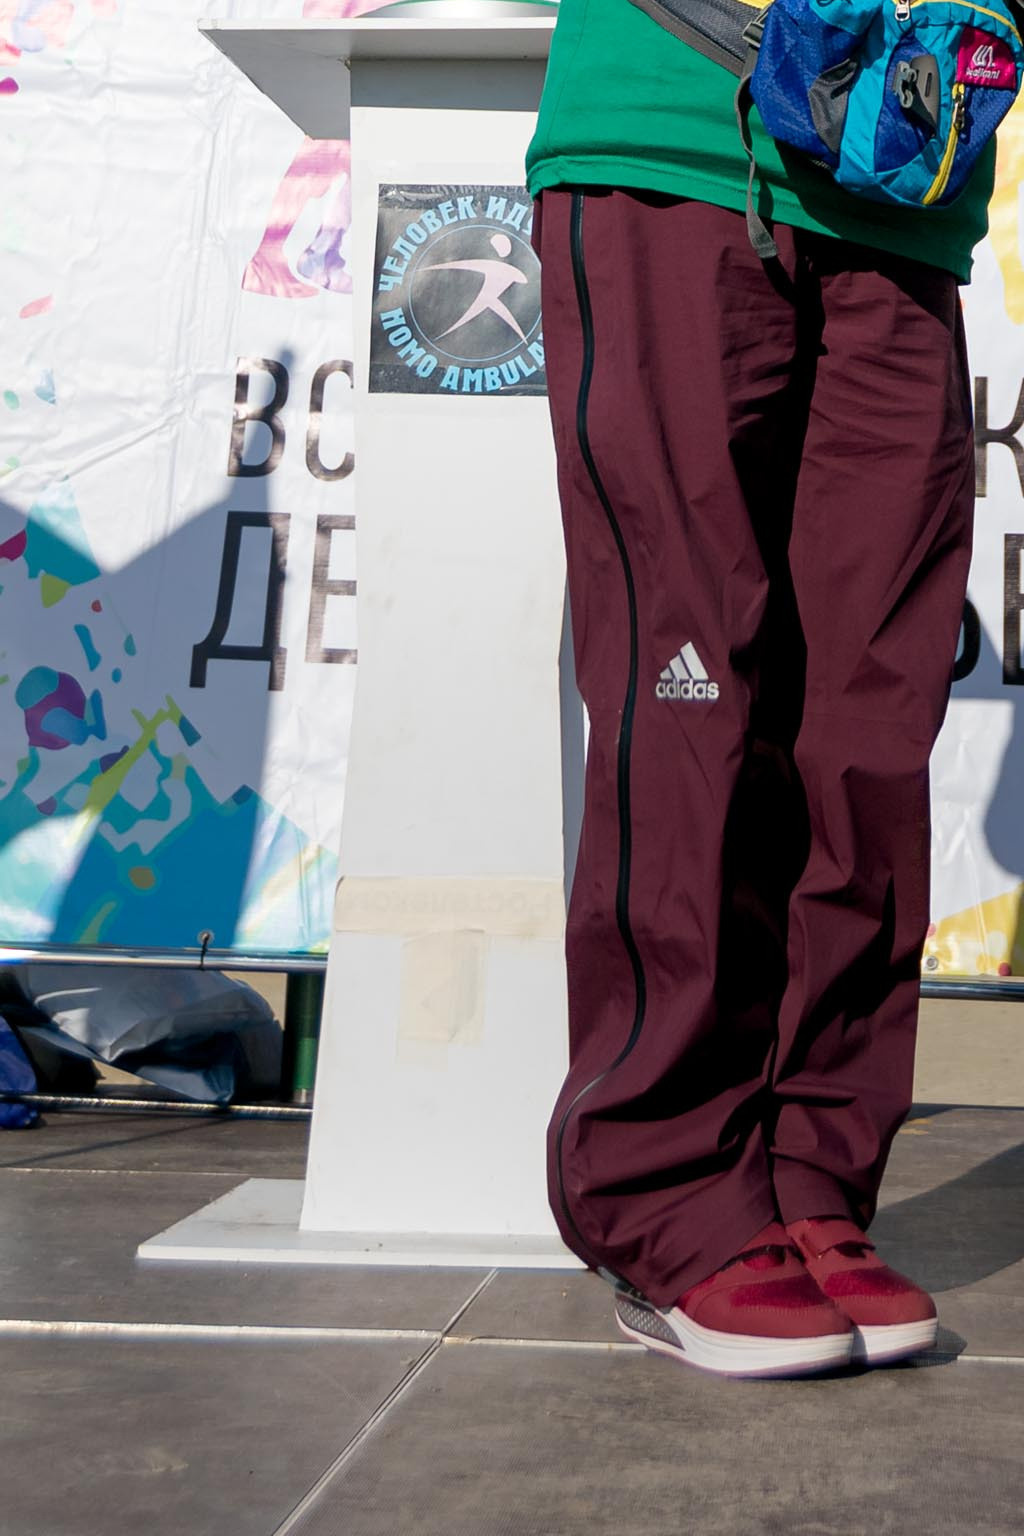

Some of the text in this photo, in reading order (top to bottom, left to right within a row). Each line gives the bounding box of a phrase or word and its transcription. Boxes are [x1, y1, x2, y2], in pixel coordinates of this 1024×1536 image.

[378, 196, 477, 292] ЧЕЛОВЕК
[380, 308, 545, 393] HOMO AMBULA
[227, 356, 355, 482] ВС
[189, 510, 358, 691] ДЕ
[655, 678, 720, 700] adidas
